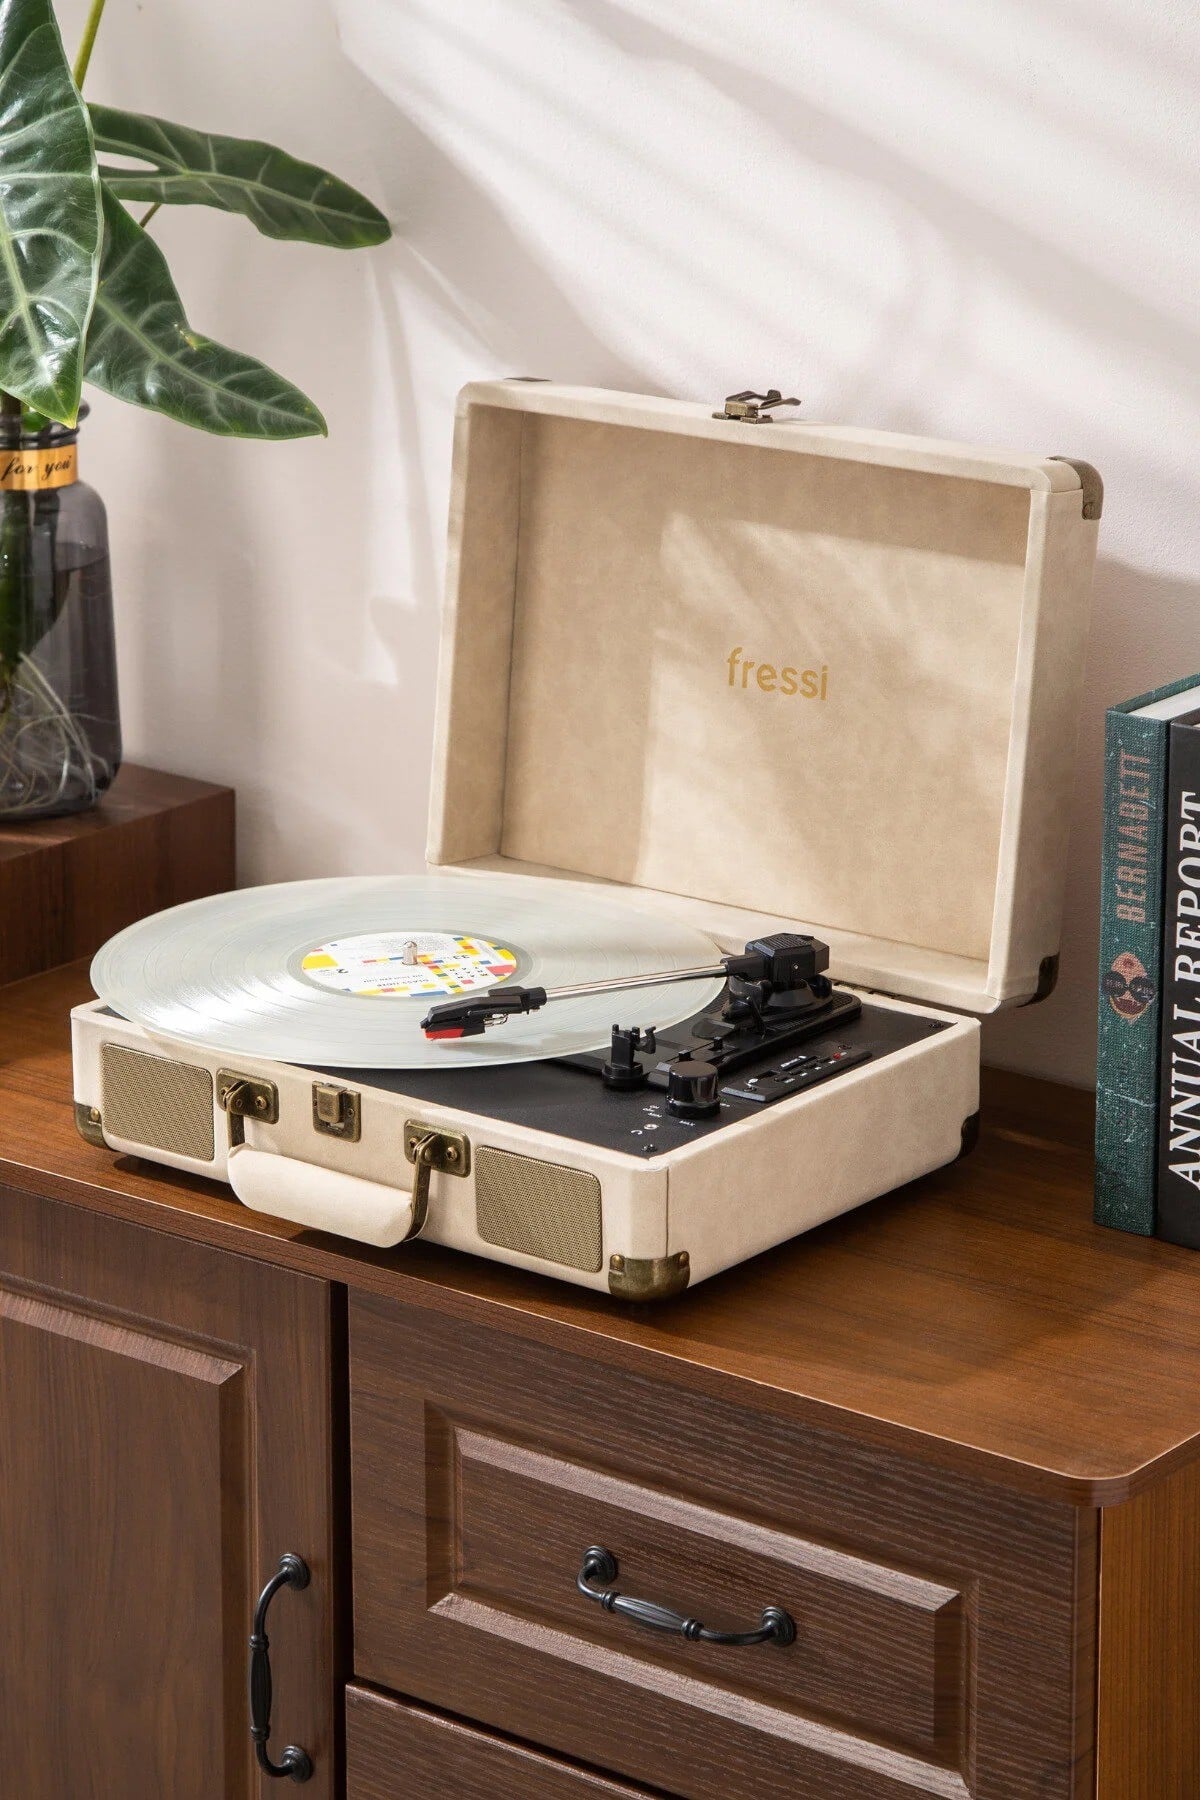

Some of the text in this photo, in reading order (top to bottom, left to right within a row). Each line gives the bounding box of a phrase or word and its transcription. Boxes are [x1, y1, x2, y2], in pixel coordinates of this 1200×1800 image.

[1, 454, 73, 482] for you
[726, 646, 829, 701] fressi
[1116, 748, 1151, 923] BERNADETT
[1168, 791, 1200, 1190] ANNUAL REPORT
